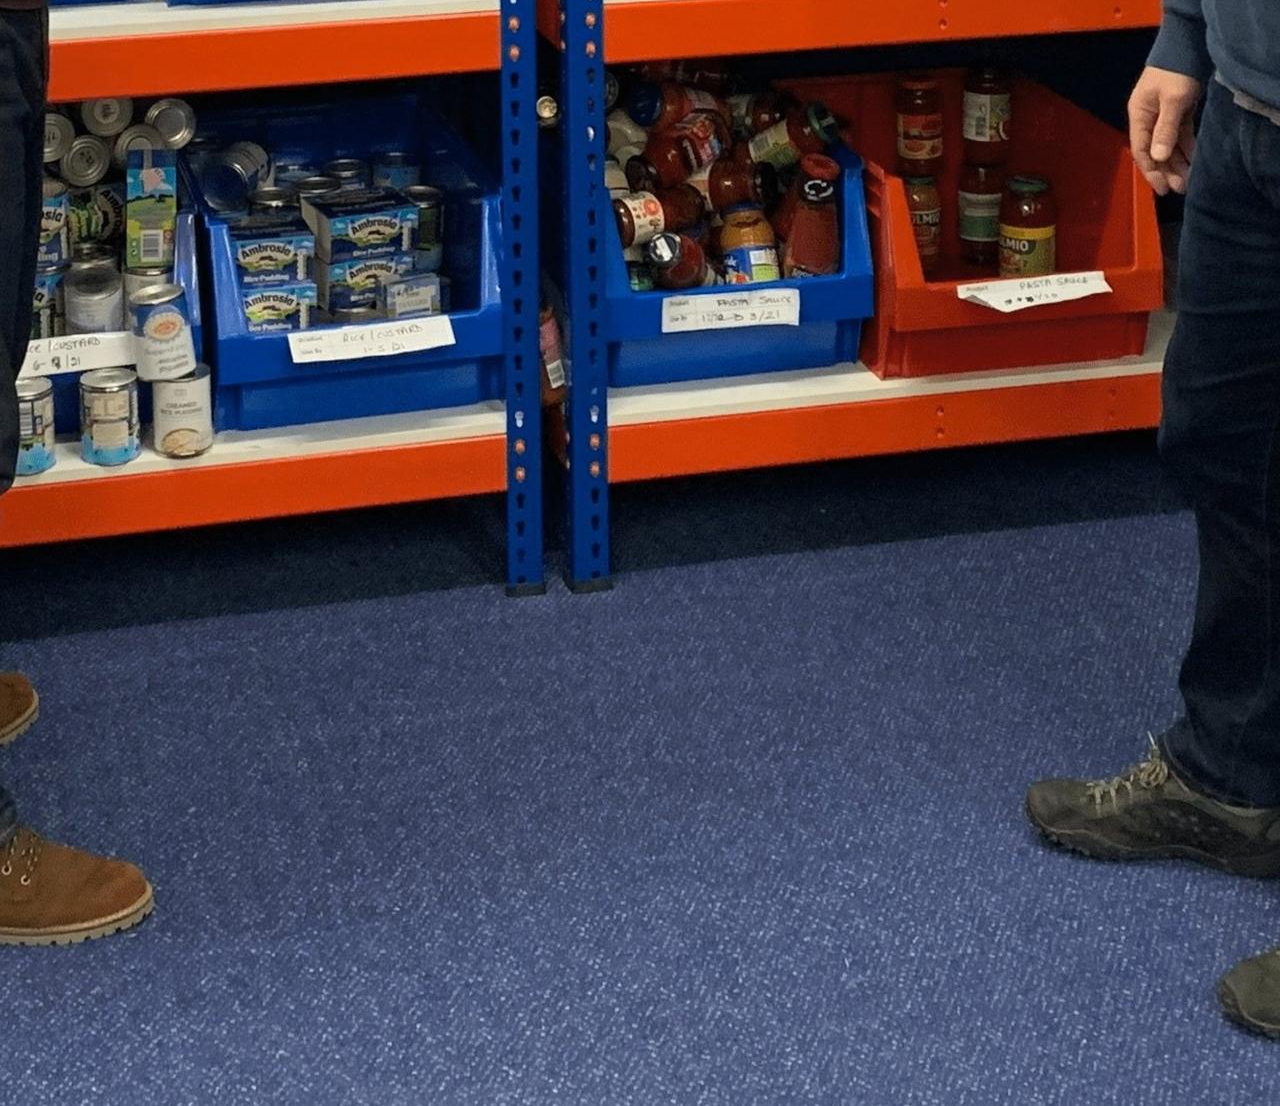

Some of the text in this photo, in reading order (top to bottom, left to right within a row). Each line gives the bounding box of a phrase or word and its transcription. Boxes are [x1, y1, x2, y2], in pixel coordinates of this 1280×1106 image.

[350, 216, 399, 236] Ambrosia
[240, 243, 292, 259] Ambrosia
[348, 262, 394, 281] Ambrosia
[243, 291, 296, 310] Ambrosia
